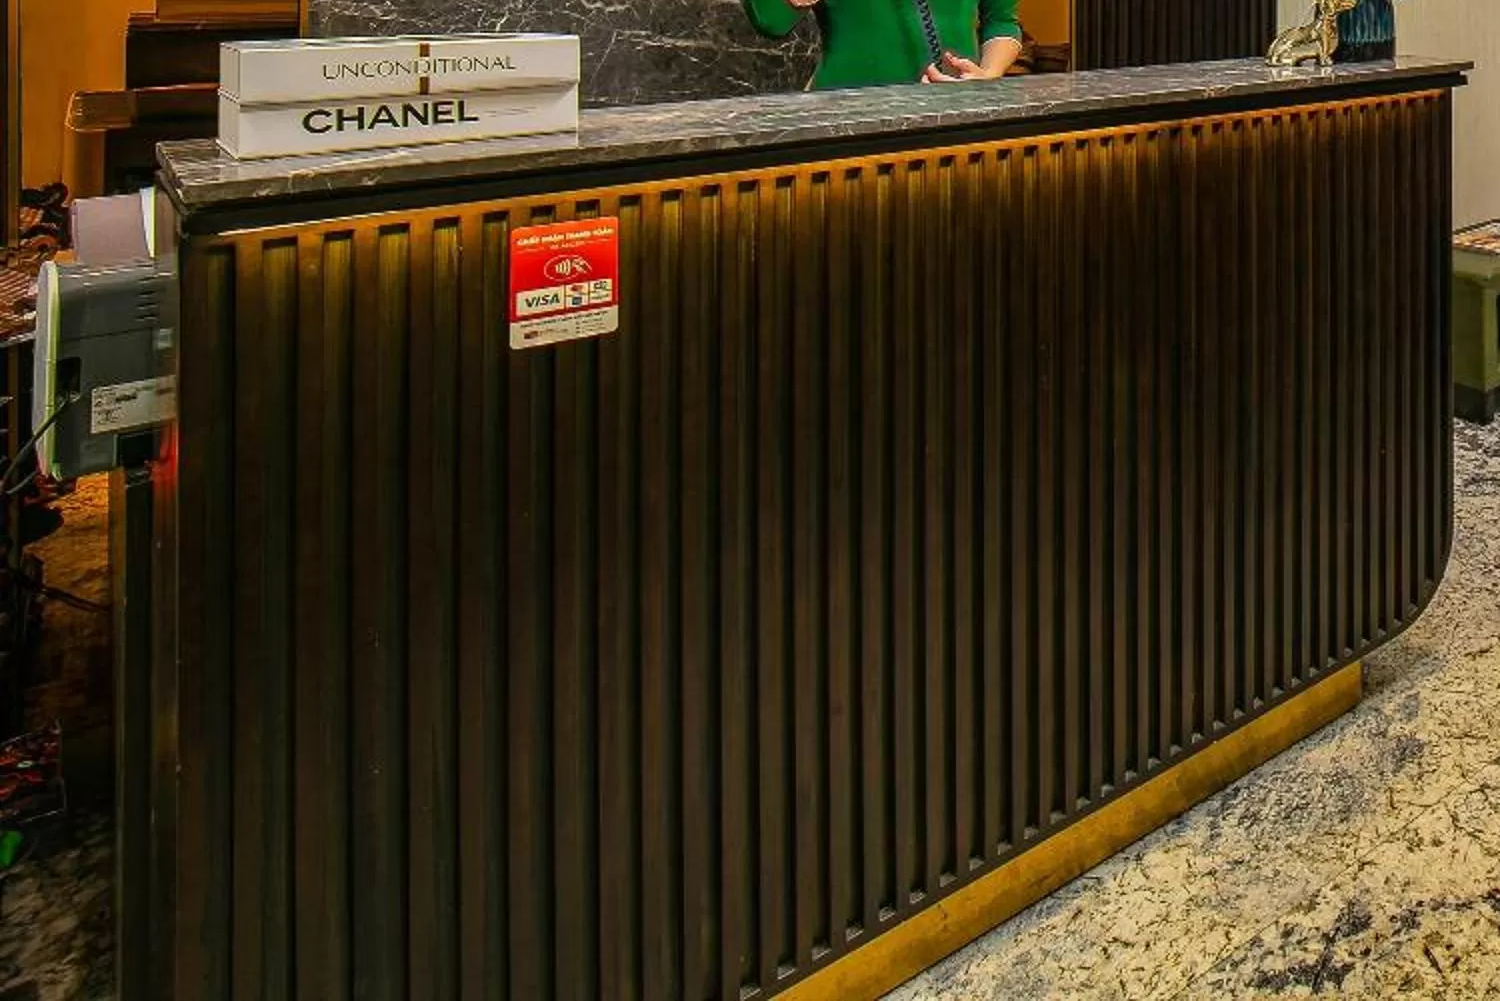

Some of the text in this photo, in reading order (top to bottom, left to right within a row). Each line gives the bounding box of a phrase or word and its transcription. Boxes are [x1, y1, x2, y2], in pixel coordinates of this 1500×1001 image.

[323, 55, 517, 80] UNCONDITIONAL
[302, 100, 480, 134] CHANEL
[525, 293, 560, 308] VISA
